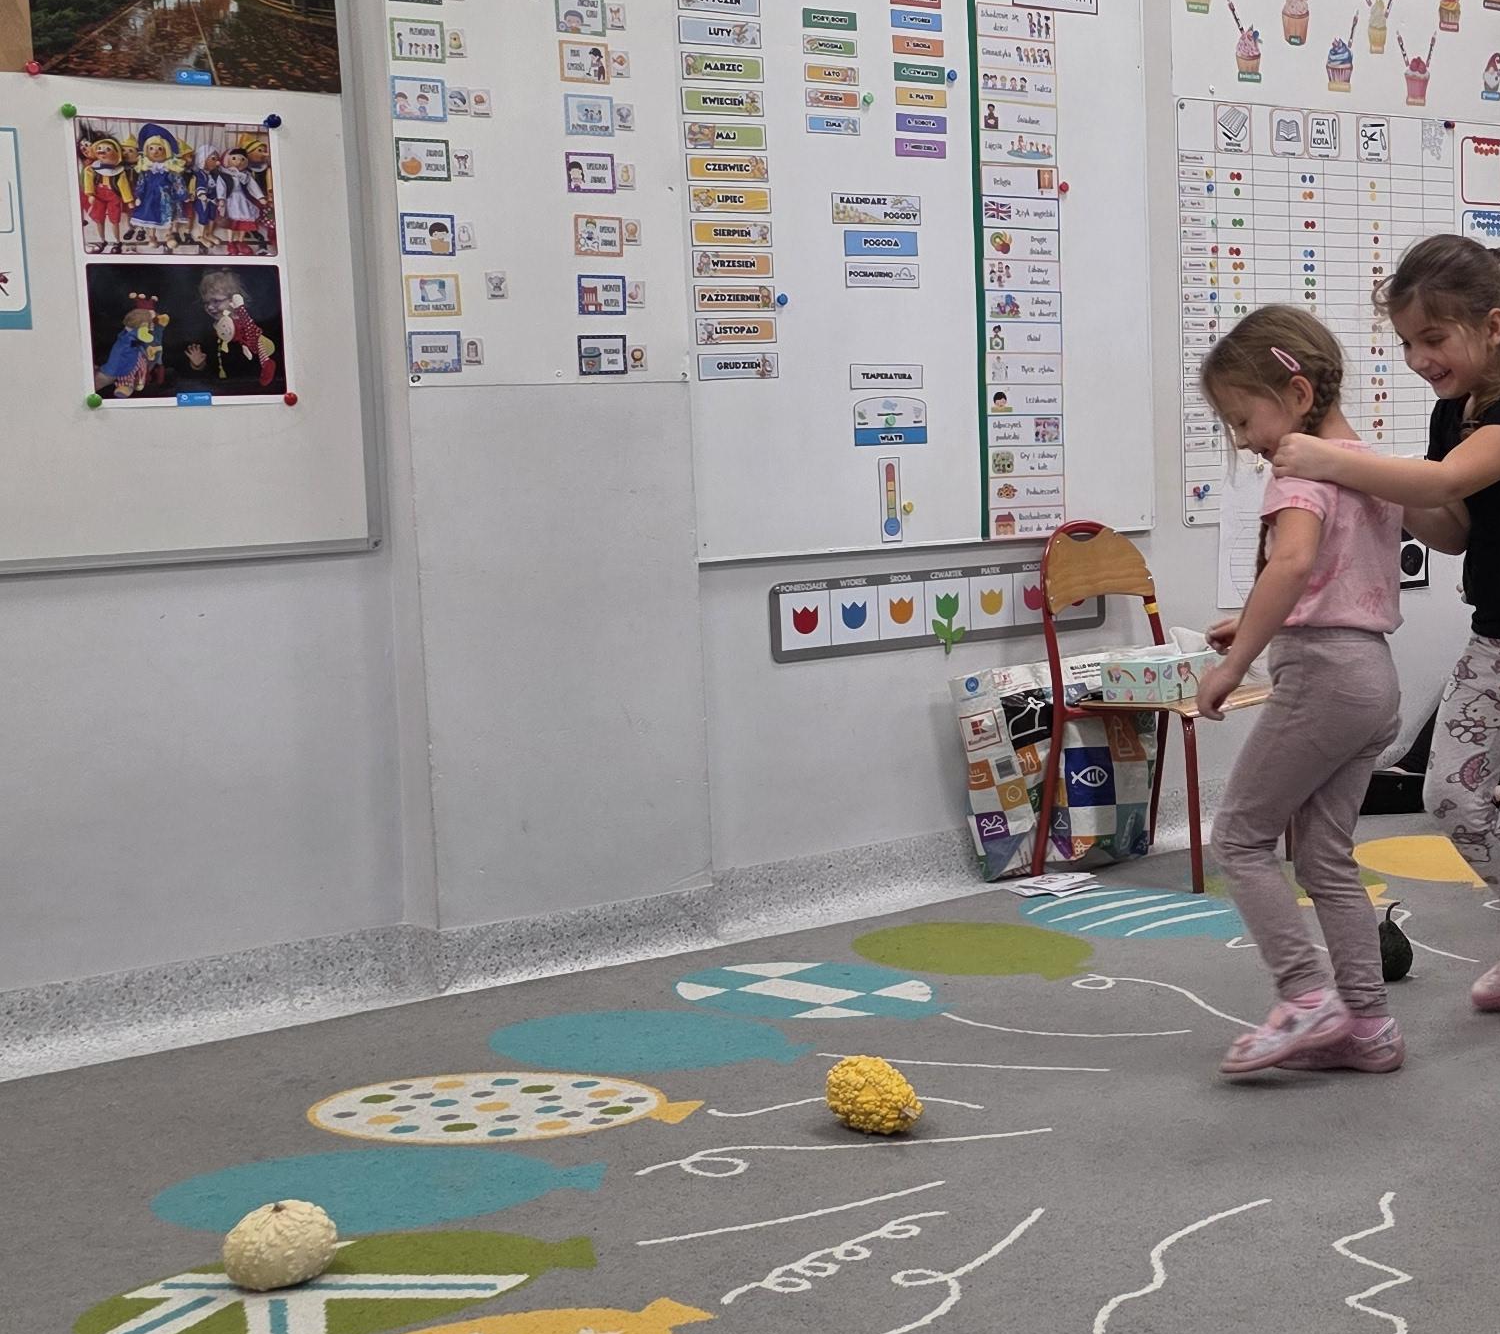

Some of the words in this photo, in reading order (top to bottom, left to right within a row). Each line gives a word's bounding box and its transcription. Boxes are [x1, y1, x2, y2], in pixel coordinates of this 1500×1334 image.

[708, 27, 732, 37] LUTY
[818, 42, 843, 50] WIOSNA
[704, 62, 743, 72] MARZEC
[702, 95, 744, 107] KWIECIEŃ
[825, 120, 841, 128] ZIMA
[716, 131, 736, 140] MAJ
[1313, 137, 1329, 145] KOTA
[705, 162, 750, 173] CZERWIEC
[717, 194, 744, 204] LIPIEC
[840, 196, 887, 206] KALENDARZ
[884, 212, 918, 221] POGODY
[713, 227, 751, 238] SIERPIEŃ
[863, 238, 900, 248] POGODA
[712, 258, 756, 269] WRZESIEŃ
[849, 270, 894, 279] POCHMURNO
[701, 291, 760, 302] PAŹDZIERNIK
[715, 325, 759, 335] LISTOPAD
[717, 359, 761, 370] GRUDZIEŃ
[861, 372, 912, 380] TEMPERATURA
[880, 434, 902, 442] WIATR
[781, 581, 828, 592] PONIEDZIAŁEK
[840, 578, 867, 587] WTOREK
[890, 574, 912, 582] ŚRODA
[930, 570, 963, 579] CZWARTEK
[981, 567, 1001, 575] PIĄTEK
